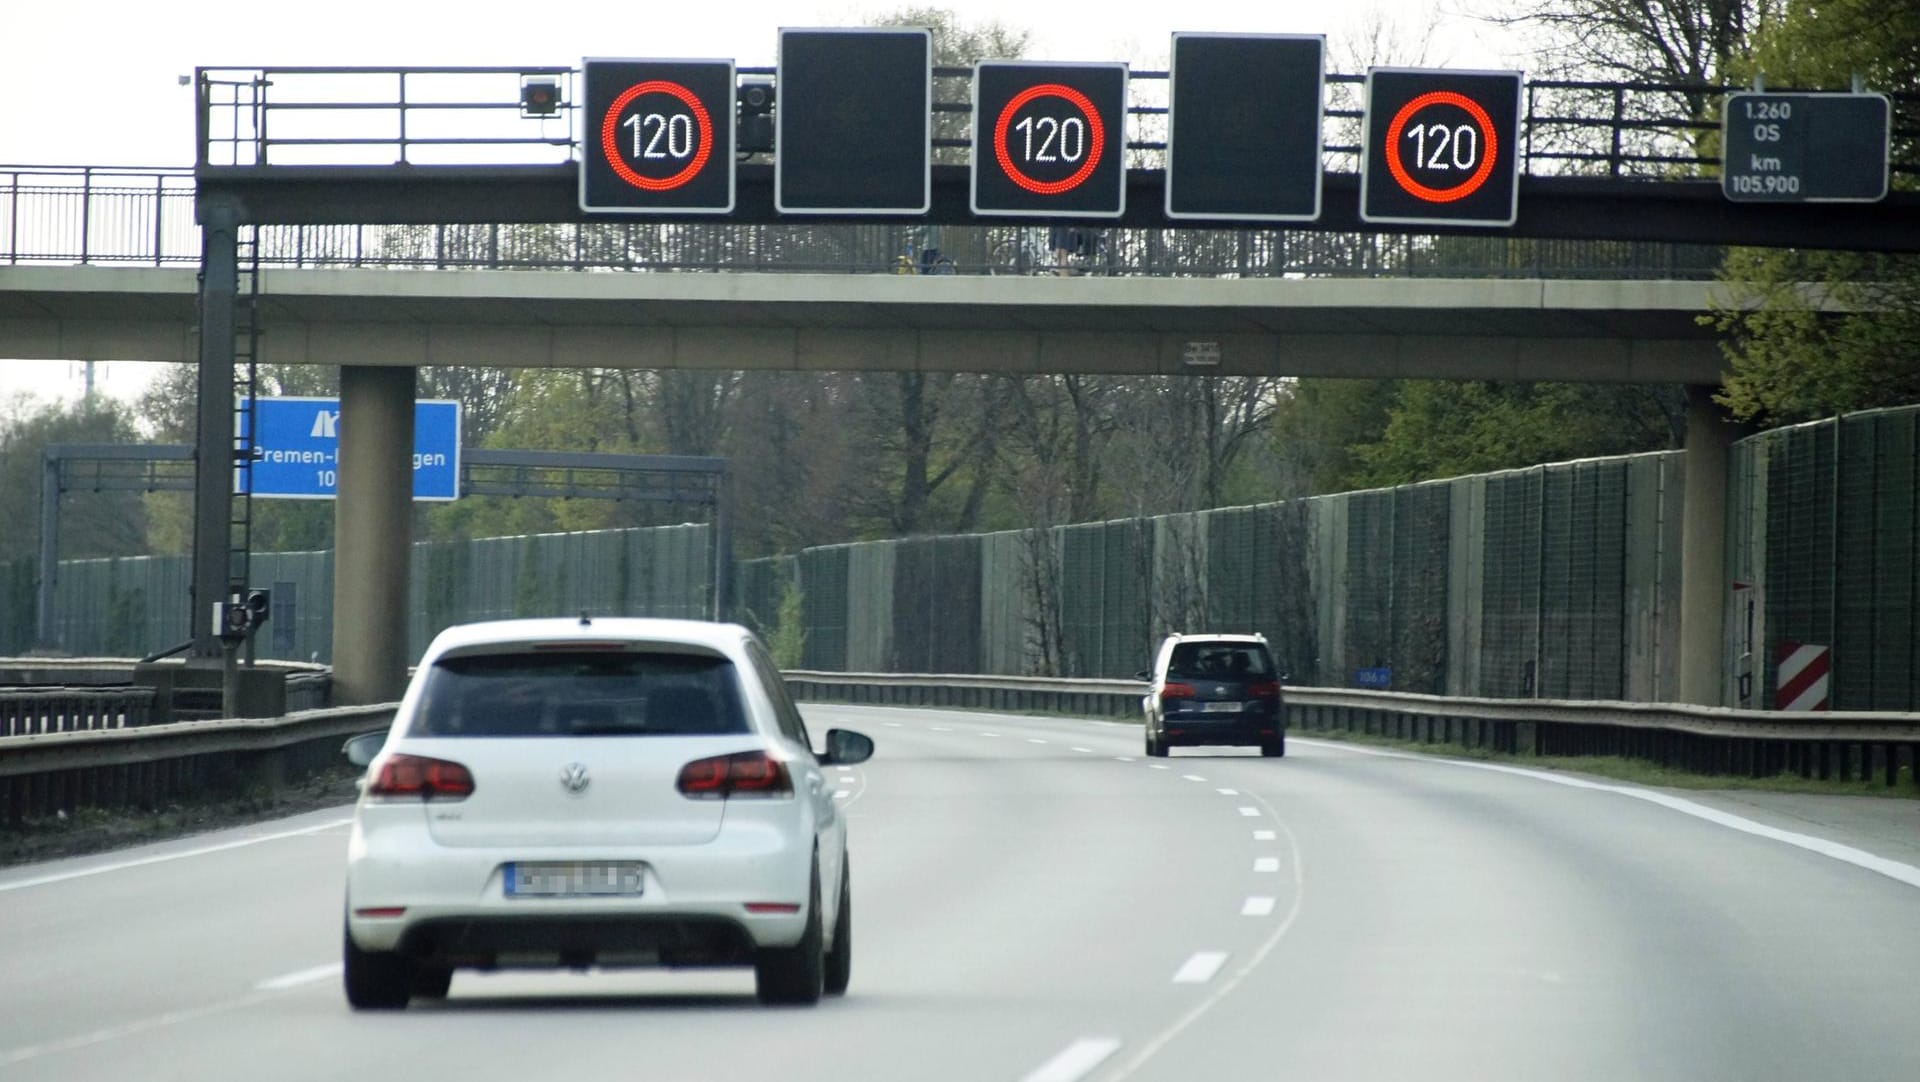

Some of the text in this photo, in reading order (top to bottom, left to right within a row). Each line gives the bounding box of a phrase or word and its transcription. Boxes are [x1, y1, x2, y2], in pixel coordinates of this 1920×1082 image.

[1745, 102, 1791, 120] 1.260
[623, 113, 692, 159] 120
[1015, 116, 1084, 163] 120
[1407, 123, 1477, 171] 120
[1751, 153, 1781, 171] km
[1732, 176, 1800, 194] 105.900
